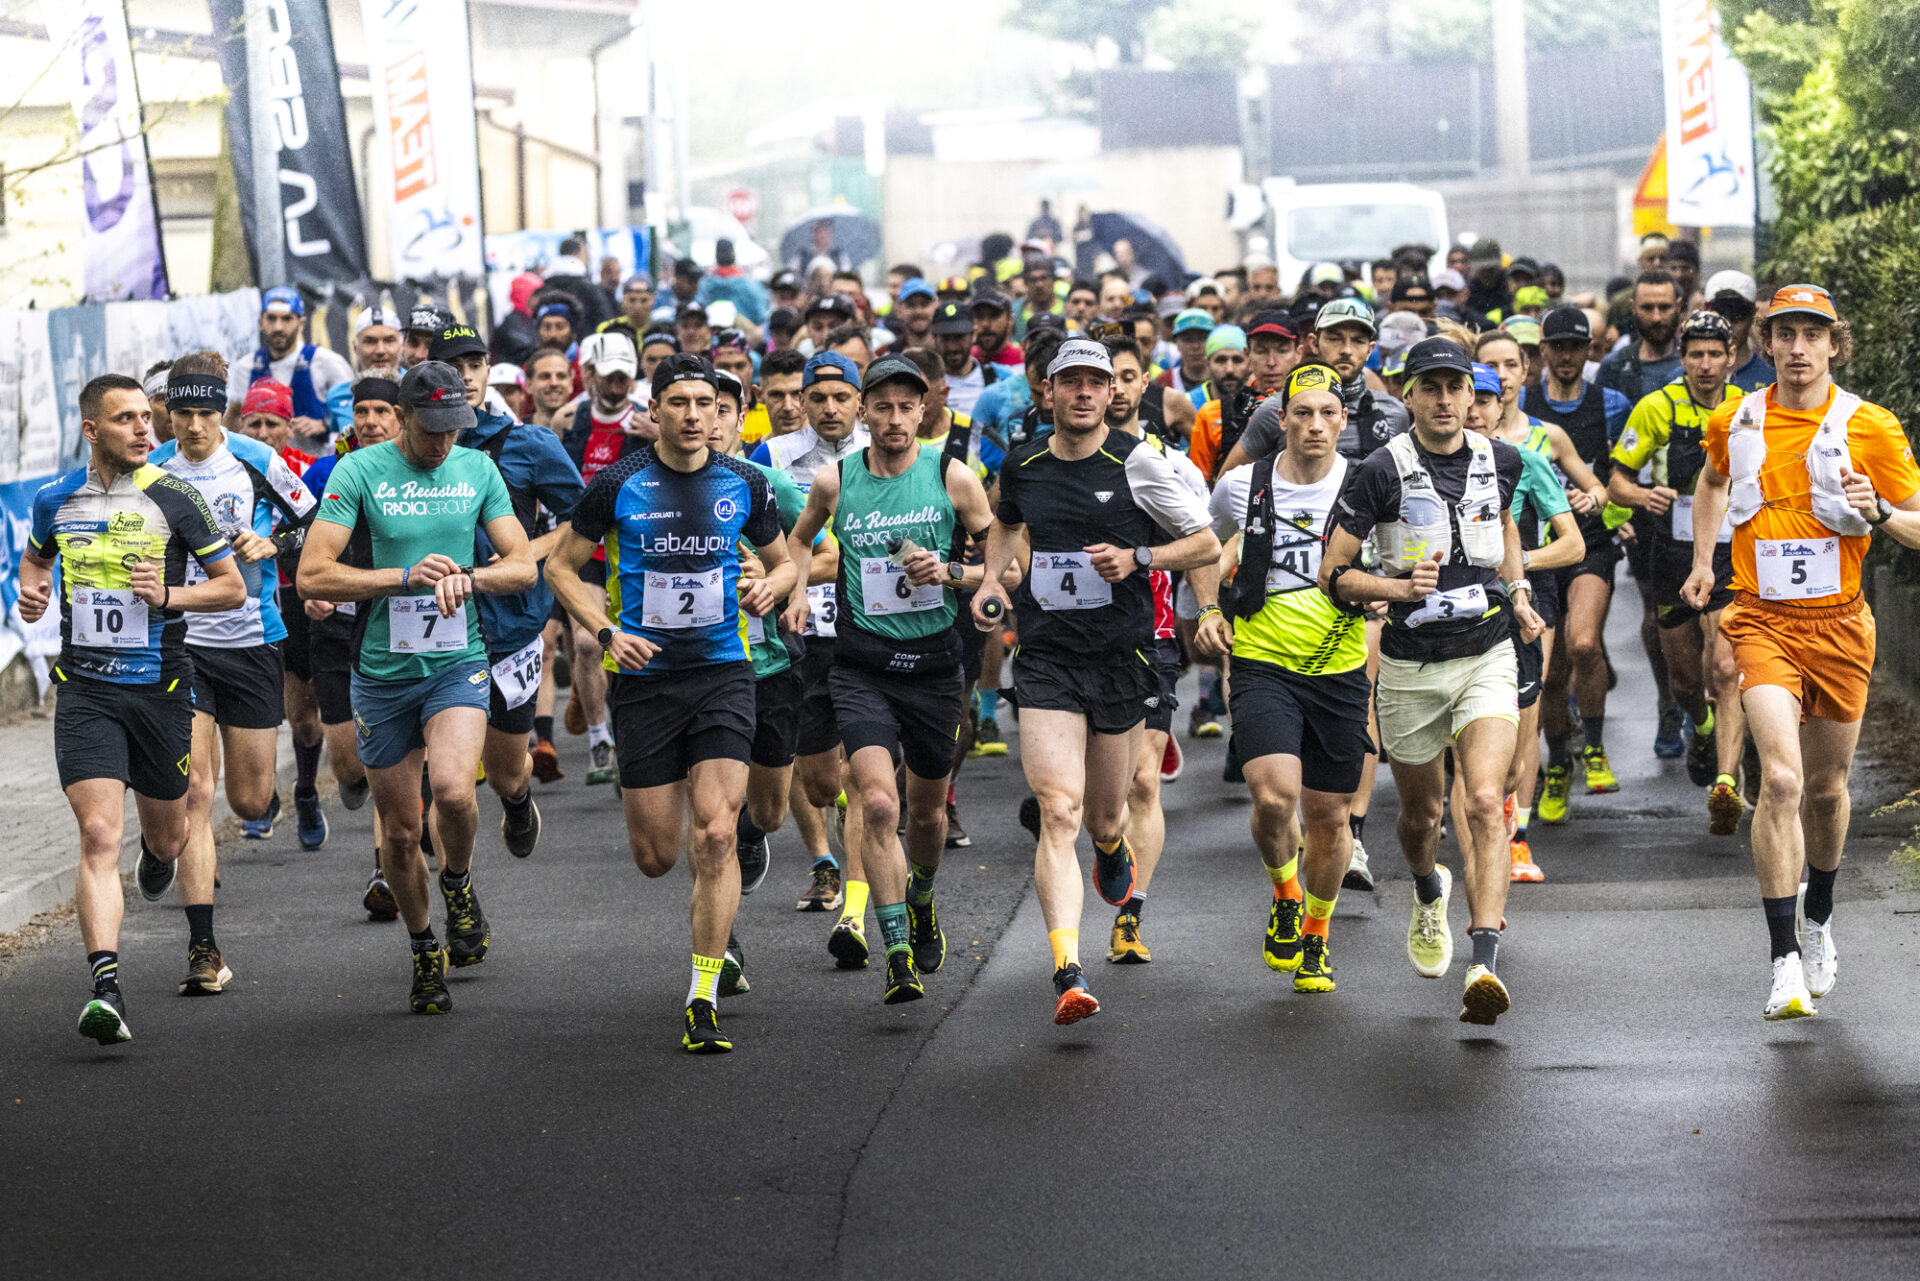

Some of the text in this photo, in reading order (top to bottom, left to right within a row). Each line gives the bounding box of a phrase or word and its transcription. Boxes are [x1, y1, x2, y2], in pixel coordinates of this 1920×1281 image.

[443, 327, 476, 340] SAMU
[1063, 348, 1107, 360] DYNAFIT
[374, 481, 477, 499] La Recastello
[383, 500, 472, 516] RADICIGROUP
[844, 506, 943, 531] La Recastello
[65, 523, 99, 531] CRAZY
[640, 532, 731, 555] Lab4you
[1282, 551, 1310, 574] 41
[1791, 560, 1807, 585] 5
[896, 576, 912, 599] 6
[1061, 572, 1077, 595] 4
[678, 592, 695, 615] 2
[1438, 600, 1455, 619] 3
[94, 609, 123, 633] 10
[423, 615, 438, 639] 7
[889, 660, 915, 669] RESS
[894, 653, 921, 661] COMP
[513, 653, 541, 691] 148
